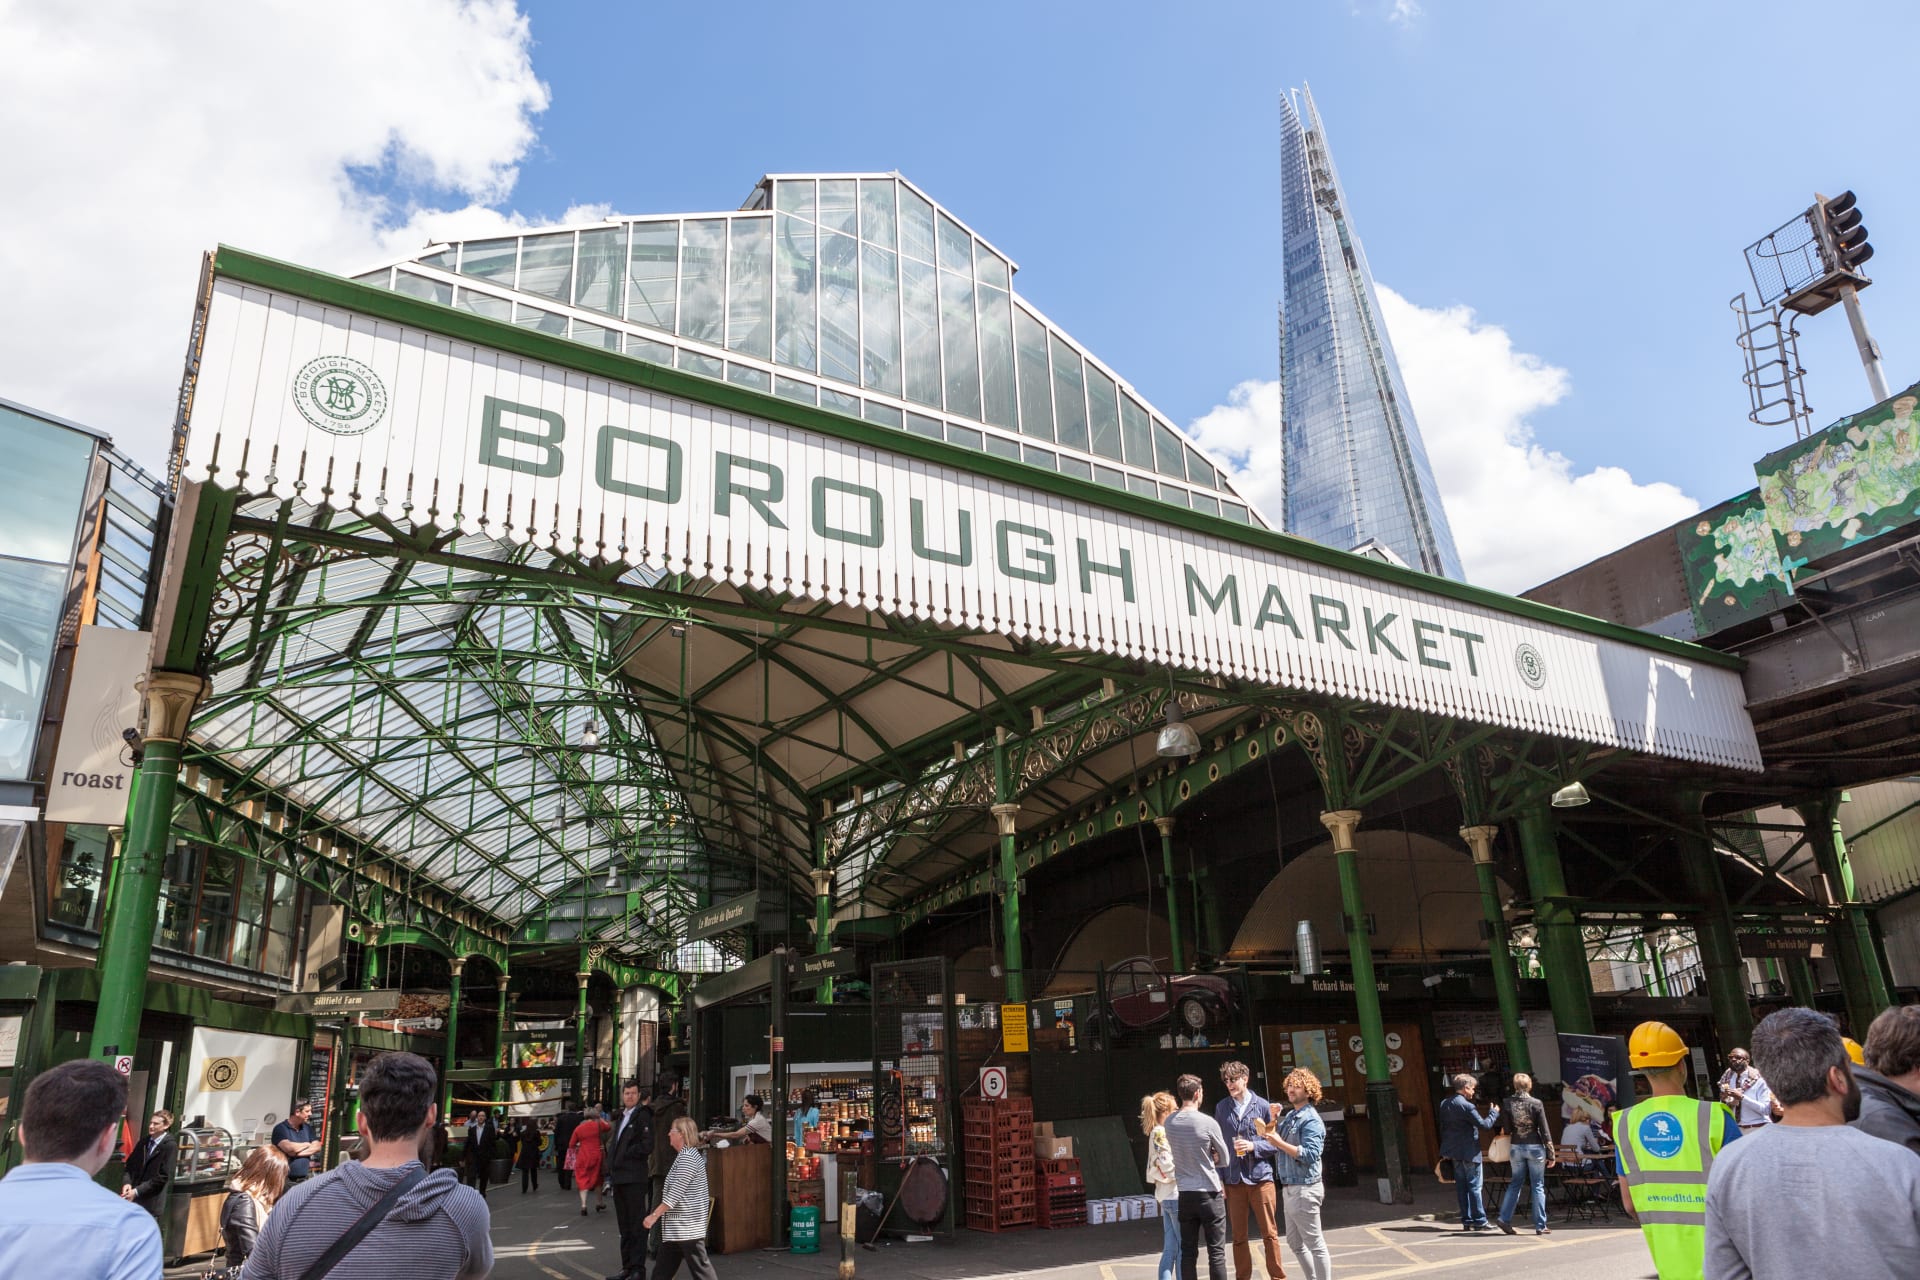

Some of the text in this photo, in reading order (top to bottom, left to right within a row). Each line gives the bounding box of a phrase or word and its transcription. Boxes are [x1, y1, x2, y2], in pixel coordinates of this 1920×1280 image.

[300, 360, 349, 398] BOROUGH
[355, 367, 382, 414] MARKET
[478, 395, 1485, 677] BOROUGH MARKET
[61, 770, 125, 790] roast
[725, 905, 744, 922] Quartier
[805, 959, 836, 973] Borough Wines
[1312, 980, 1338, 992] Richard
[1340, 981, 1356, 992] Hawa
[314, 995, 363, 1006] Sillfield Farm
[990, 1077, 998, 1090] 5
